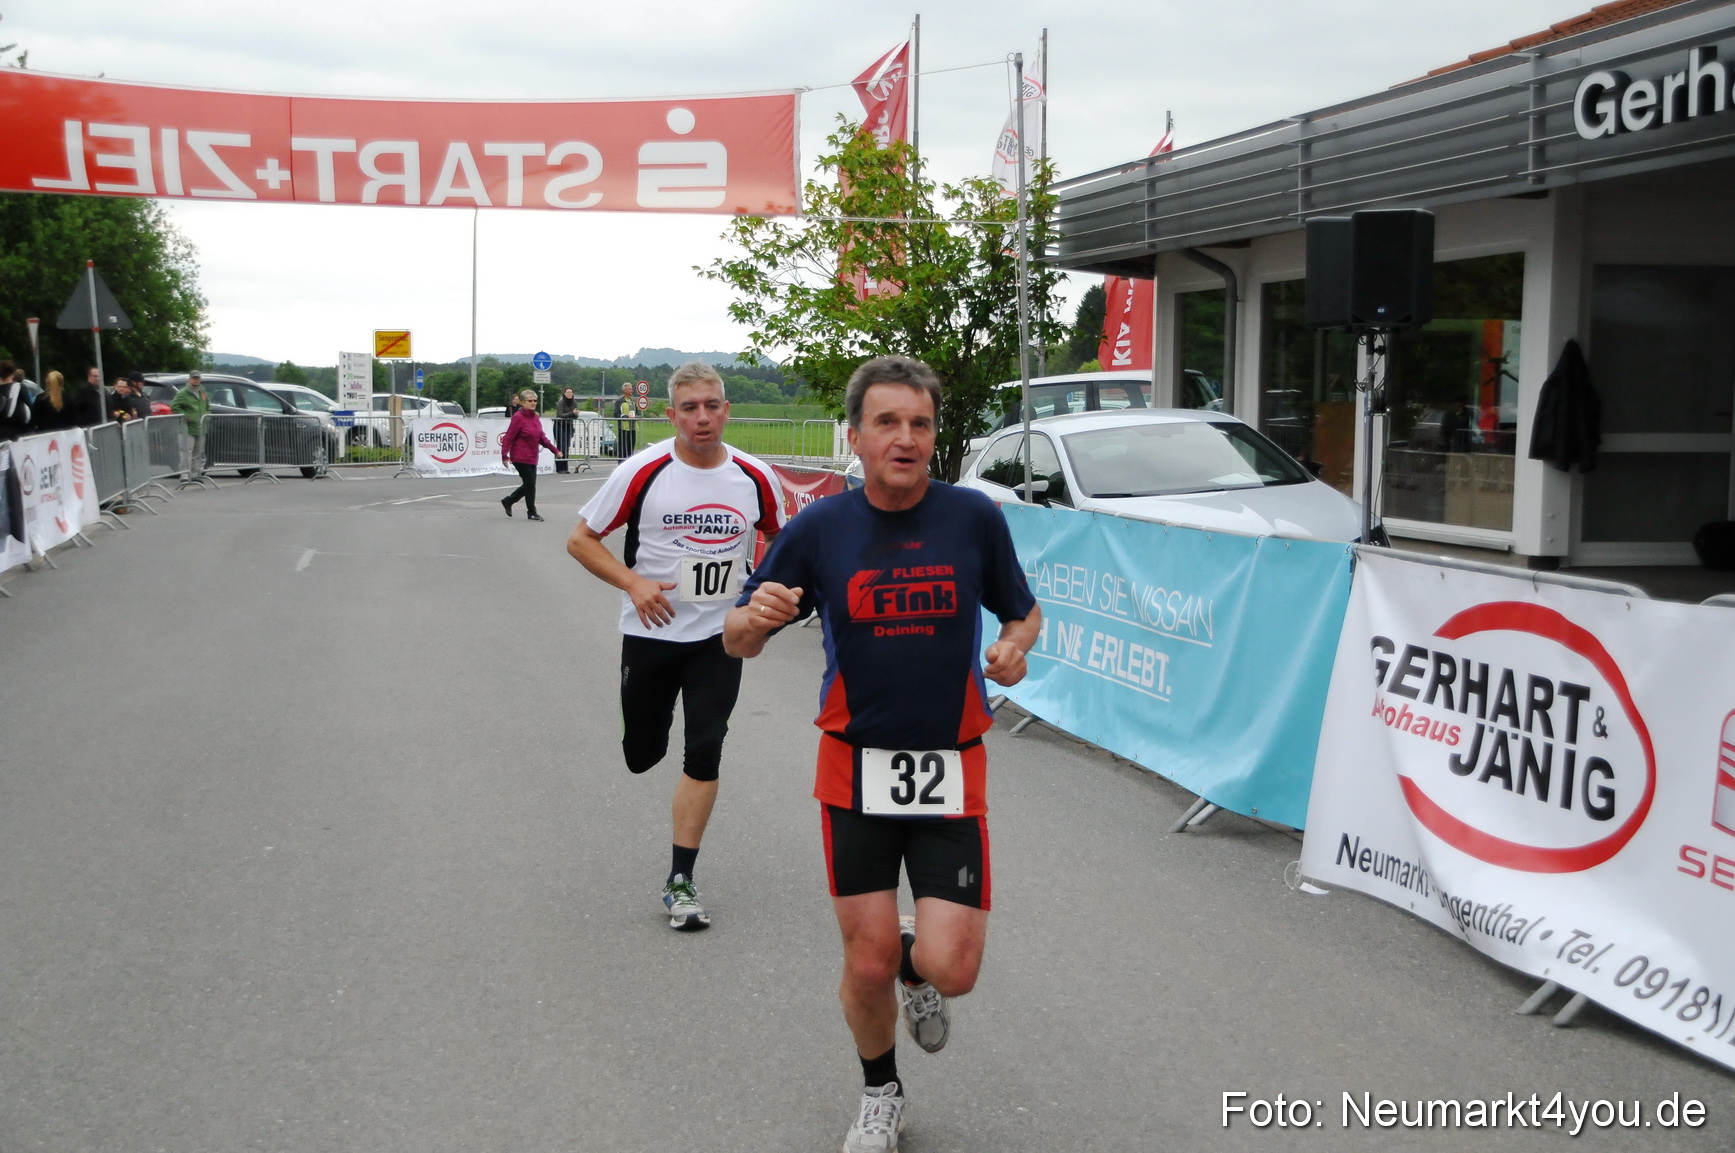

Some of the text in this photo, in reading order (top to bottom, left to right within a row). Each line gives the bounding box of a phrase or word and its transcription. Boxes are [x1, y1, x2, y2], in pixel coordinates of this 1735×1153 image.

[1574, 48, 1735, 140] Gerh
[1111, 322, 1132, 366] KIA
[418, 432, 459, 443] GERHART
[662, 513, 733, 525] GERHART
[672, 538, 685, 549] Das
[692, 560, 733, 597] 107
[892, 565, 955, 579] FLIESEN
[872, 583, 955, 615] Fink
[1025, 558, 1213, 641] HABEN SIE NISSAN
[873, 624, 936, 638] Deining
[1056, 620, 1085, 663] NIE
[1086, 630, 1172, 696] ERLEBT.
[1370, 635, 1609, 747] GERHART &
[890, 751, 946, 806] 32
[1448, 722, 1616, 823] JÄNIG
[1676, 844, 1735, 891] SE
[1335, 832, 1430, 899] Neumarkt
[1555, 928, 1615, 974] Tel.
